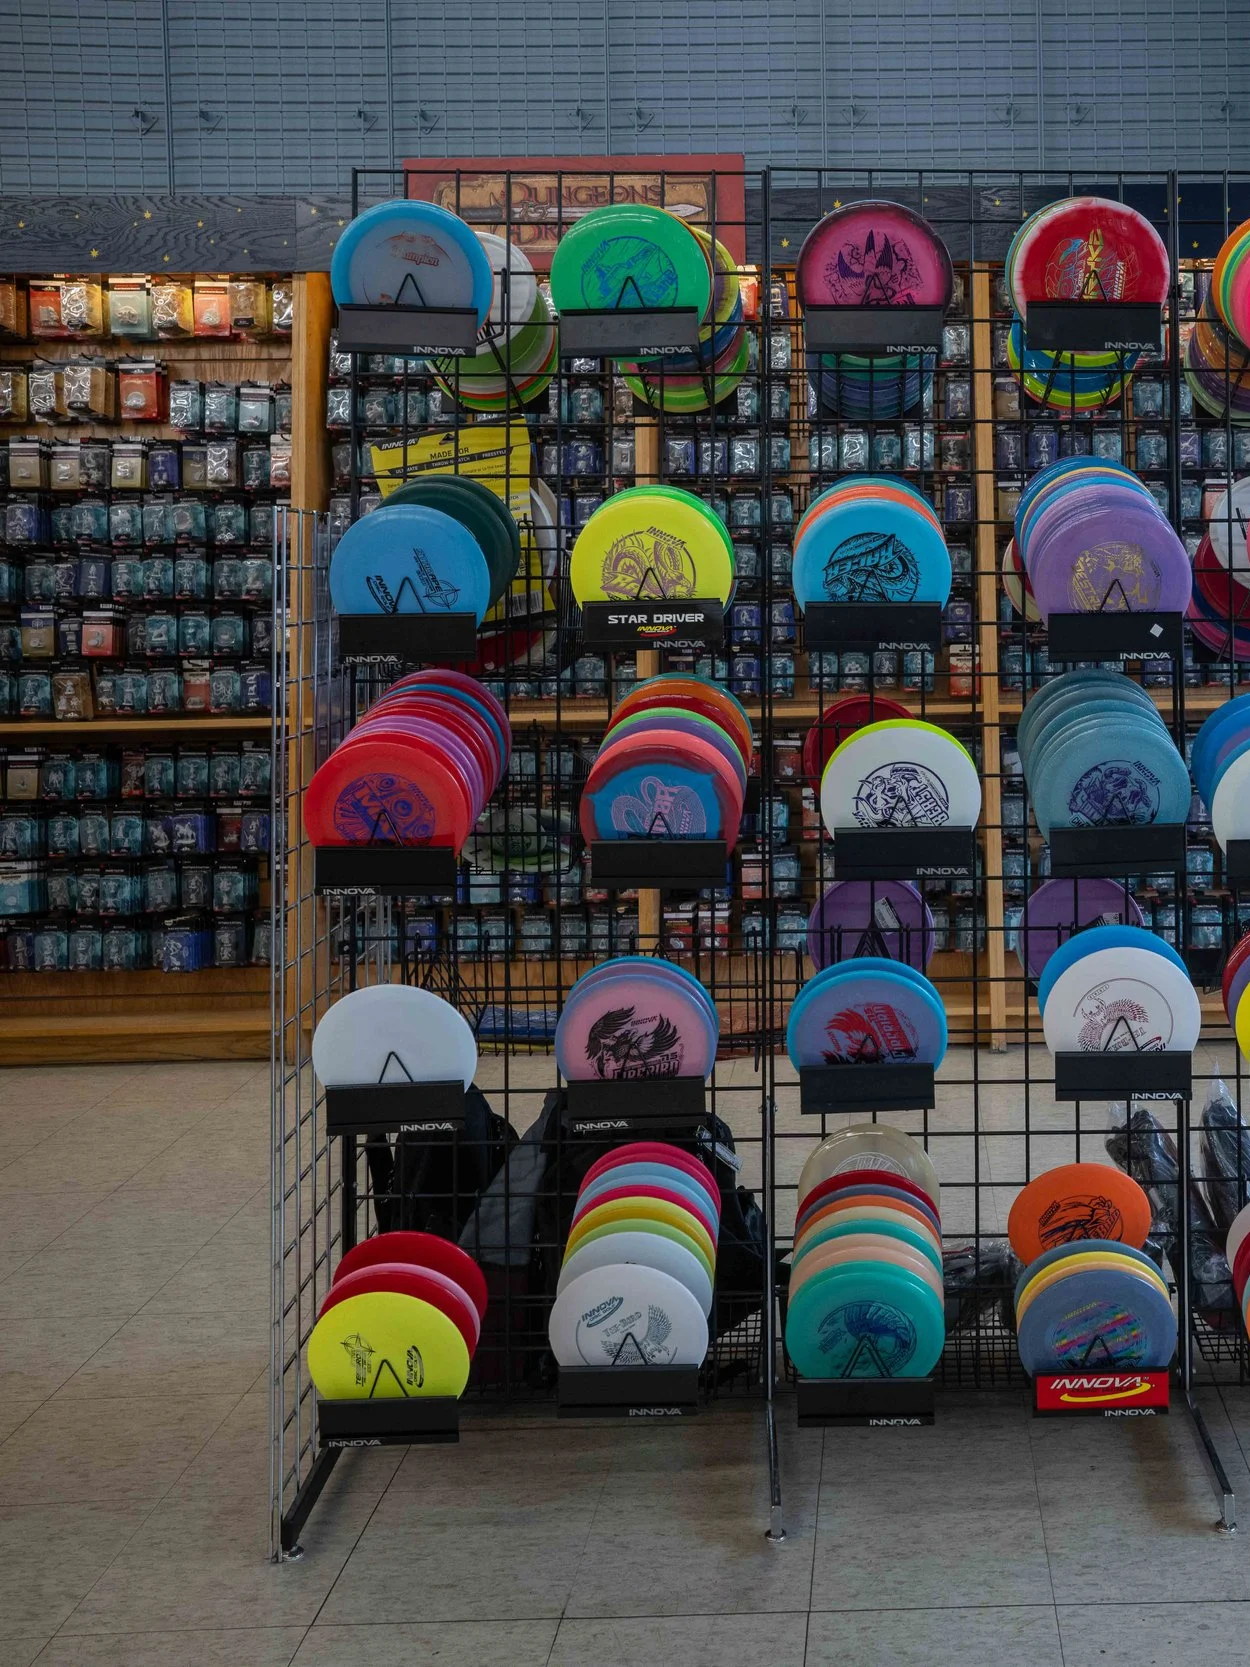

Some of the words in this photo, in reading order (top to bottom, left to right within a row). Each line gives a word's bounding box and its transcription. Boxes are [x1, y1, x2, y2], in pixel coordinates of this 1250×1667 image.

[504, 181, 662, 205] DUNGEONS
[413, 345, 466, 356] INNOVA
[640, 345, 692, 356] INNOVA
[886, 345, 938, 353] INNOVA
[1105, 341, 1155, 350] INNOVA
[429, 450, 453, 460] MADE
[646, 526, 687, 548] INNOVA
[825, 541, 895, 583] RACER
[608, 614, 648, 624] STAR
[653, 613, 705, 623] DRIVER
[653, 640, 706, 649] INNOVA
[878, 641, 931, 650] INNOVA
[345, 655, 399, 664] INNOVA
[1120, 651, 1171, 660] INNOVA
[1132, 760, 1160, 787] INNOVA
[912, 783, 949, 826] BEAST
[916, 867, 969, 875] INNOVA
[322, 887, 376, 896] INNOVA
[630, 1015, 659, 1027] INNOVA
[1131, 1092, 1183, 1100] INNOVA
[400, 1121, 454, 1132] INNOVA
[576, 1120, 629, 1131] INNOVA
[581, 1295, 619, 1321] INNOVA
[1064, 1301, 1098, 1320] INNOVA
[588, 1312, 604, 1324] DISC
[1050, 1376, 1141, 1389] INNOVA
[629, 1407, 683, 1416] INNOVA
[1105, 1408, 1156, 1417] INNOVA
[869, 1417, 922, 1426] INNOVA
[328, 1438, 382, 1448] INNOVA
